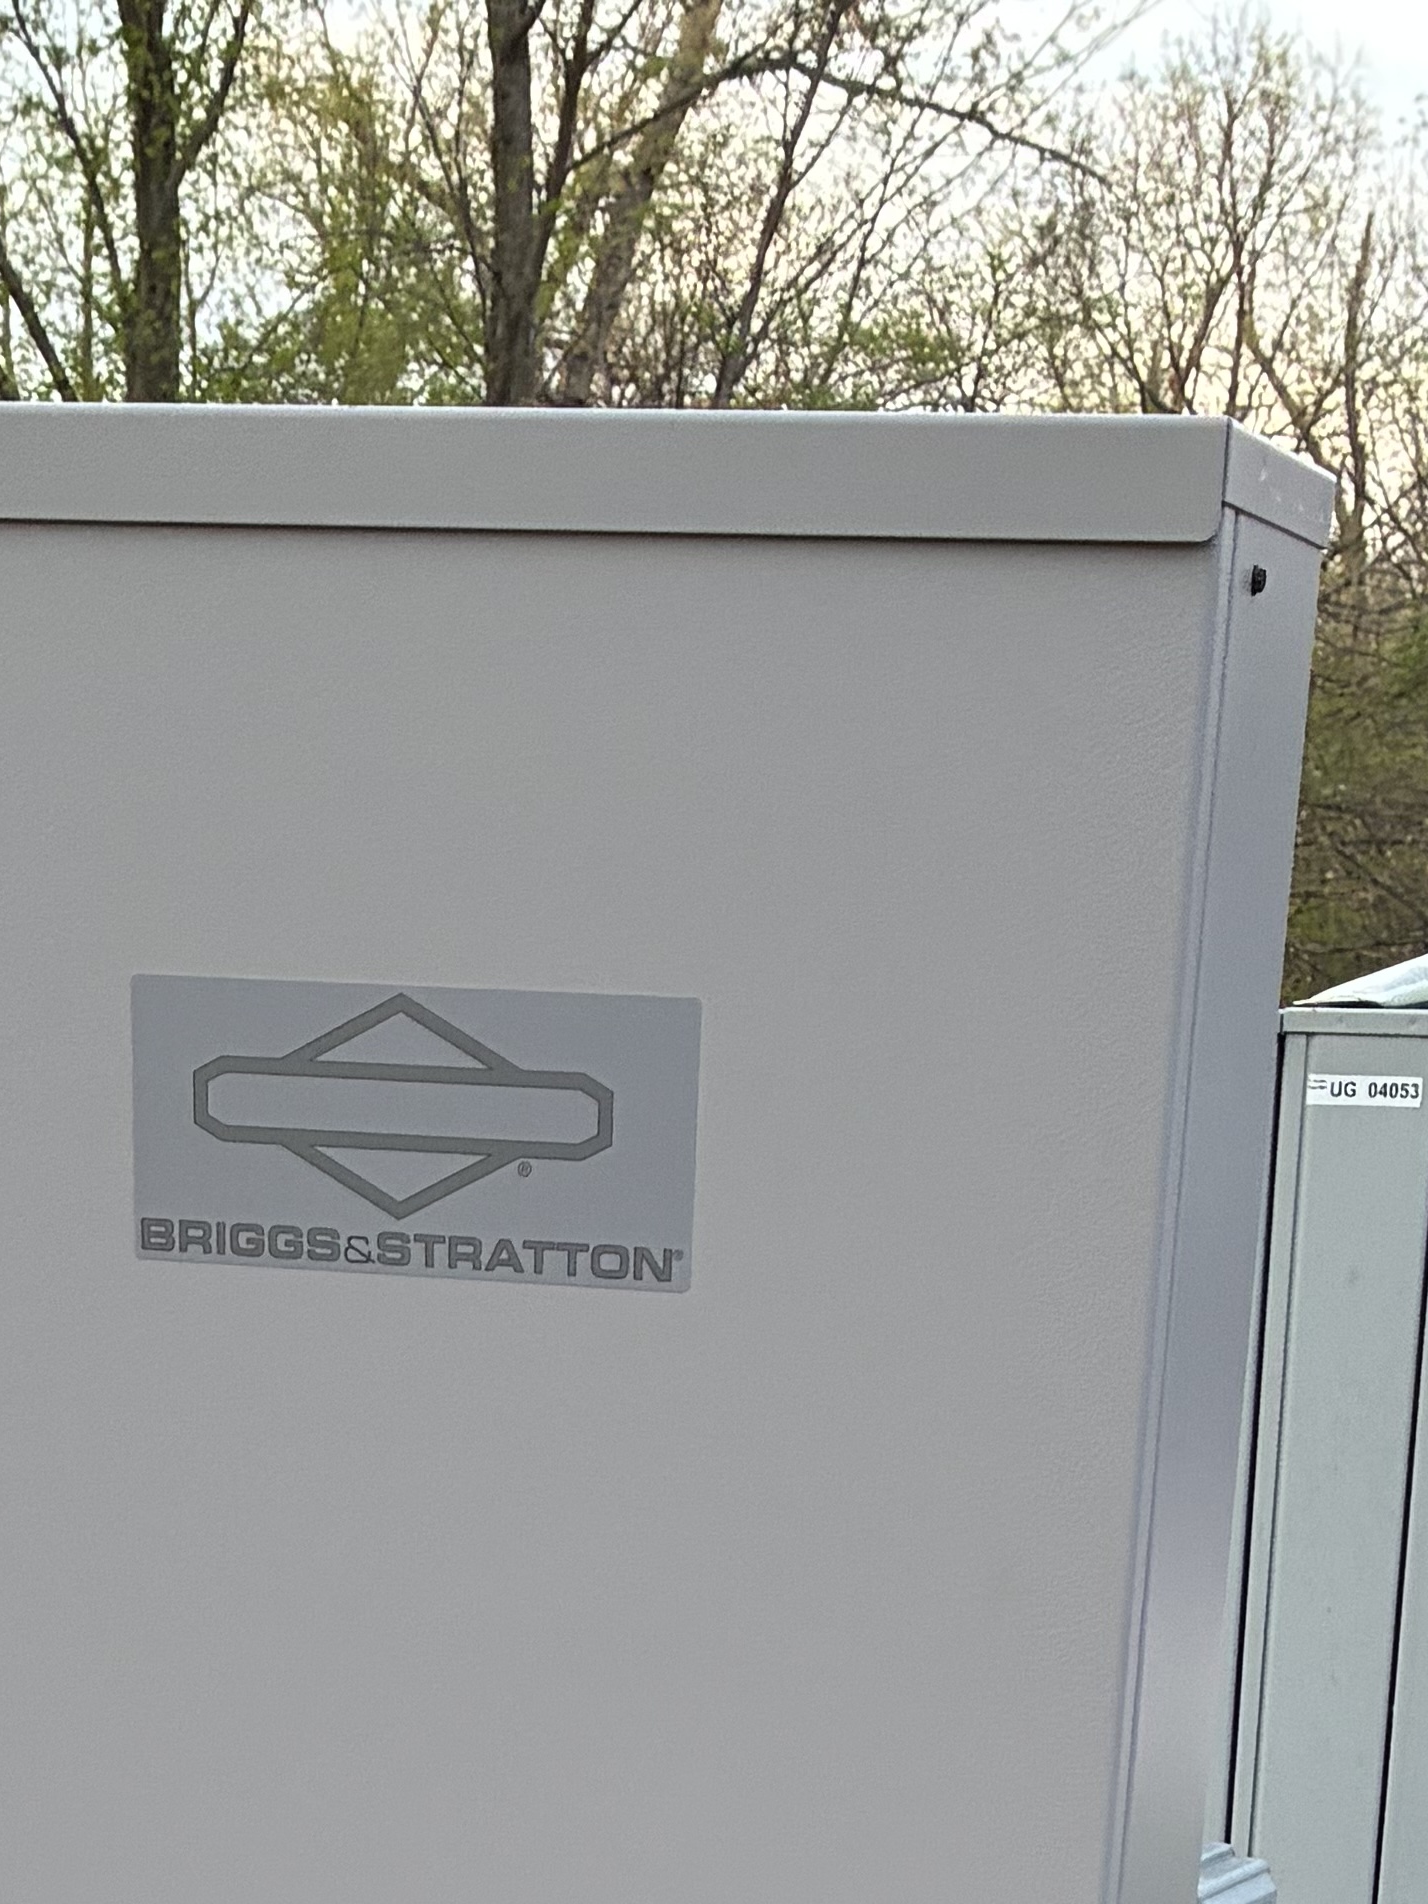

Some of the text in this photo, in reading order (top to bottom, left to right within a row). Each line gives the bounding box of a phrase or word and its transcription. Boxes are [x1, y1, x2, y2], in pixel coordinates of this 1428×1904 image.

[1330, 1081, 1420, 1099] UG 04053
[140, 1217, 674, 1282] BRIGGS&STRATTON
